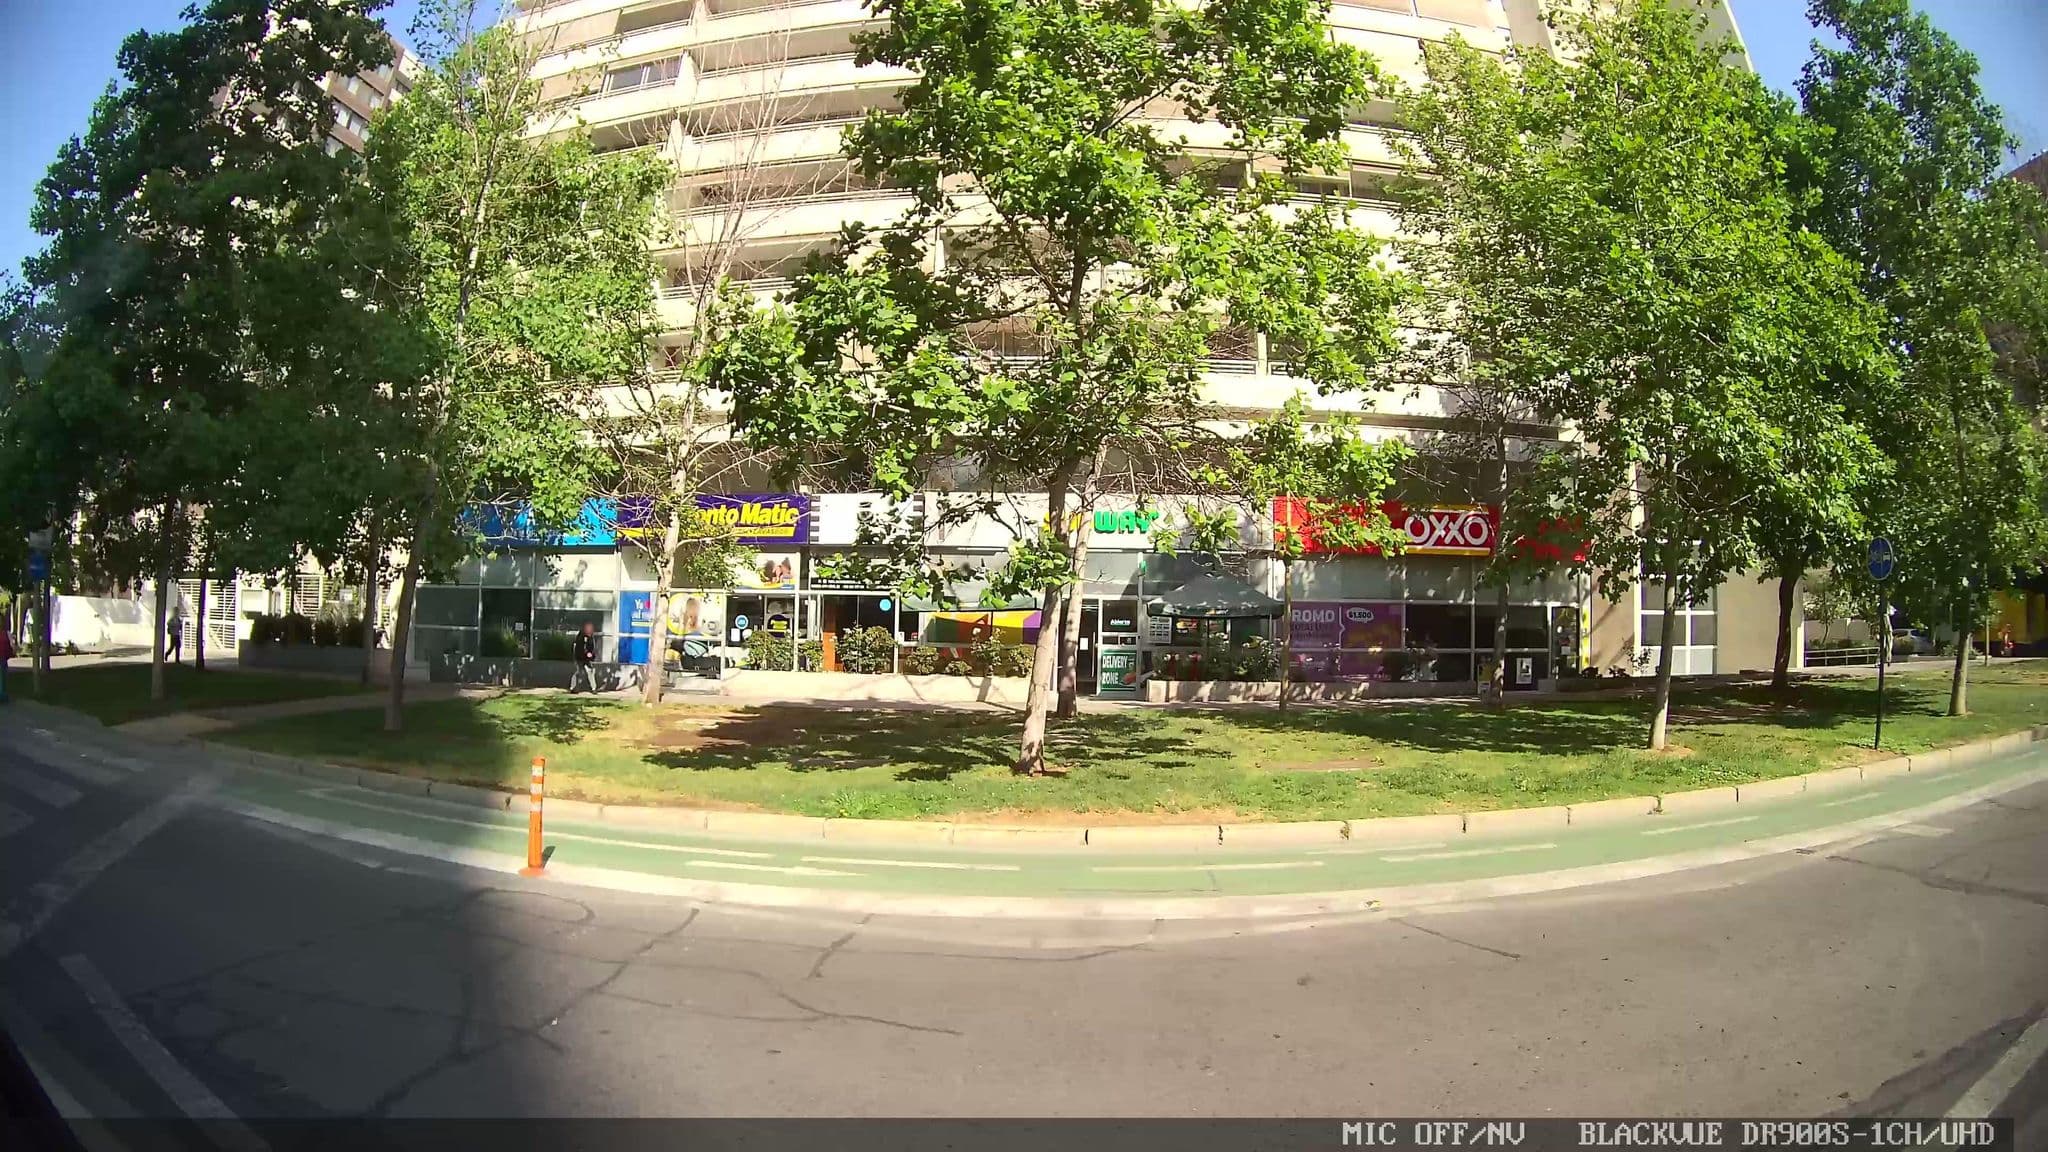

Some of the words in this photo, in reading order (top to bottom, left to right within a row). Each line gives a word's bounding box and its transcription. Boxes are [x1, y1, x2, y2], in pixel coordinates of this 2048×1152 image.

[740, 502, 799, 525] Matic
[1404, 512, 1489, 547] OXXO
[1291, 609, 1335, 623] ROMO
[1102, 655, 1128, 669] DELIVERY
[1102, 671, 1119, 685] ZONE
